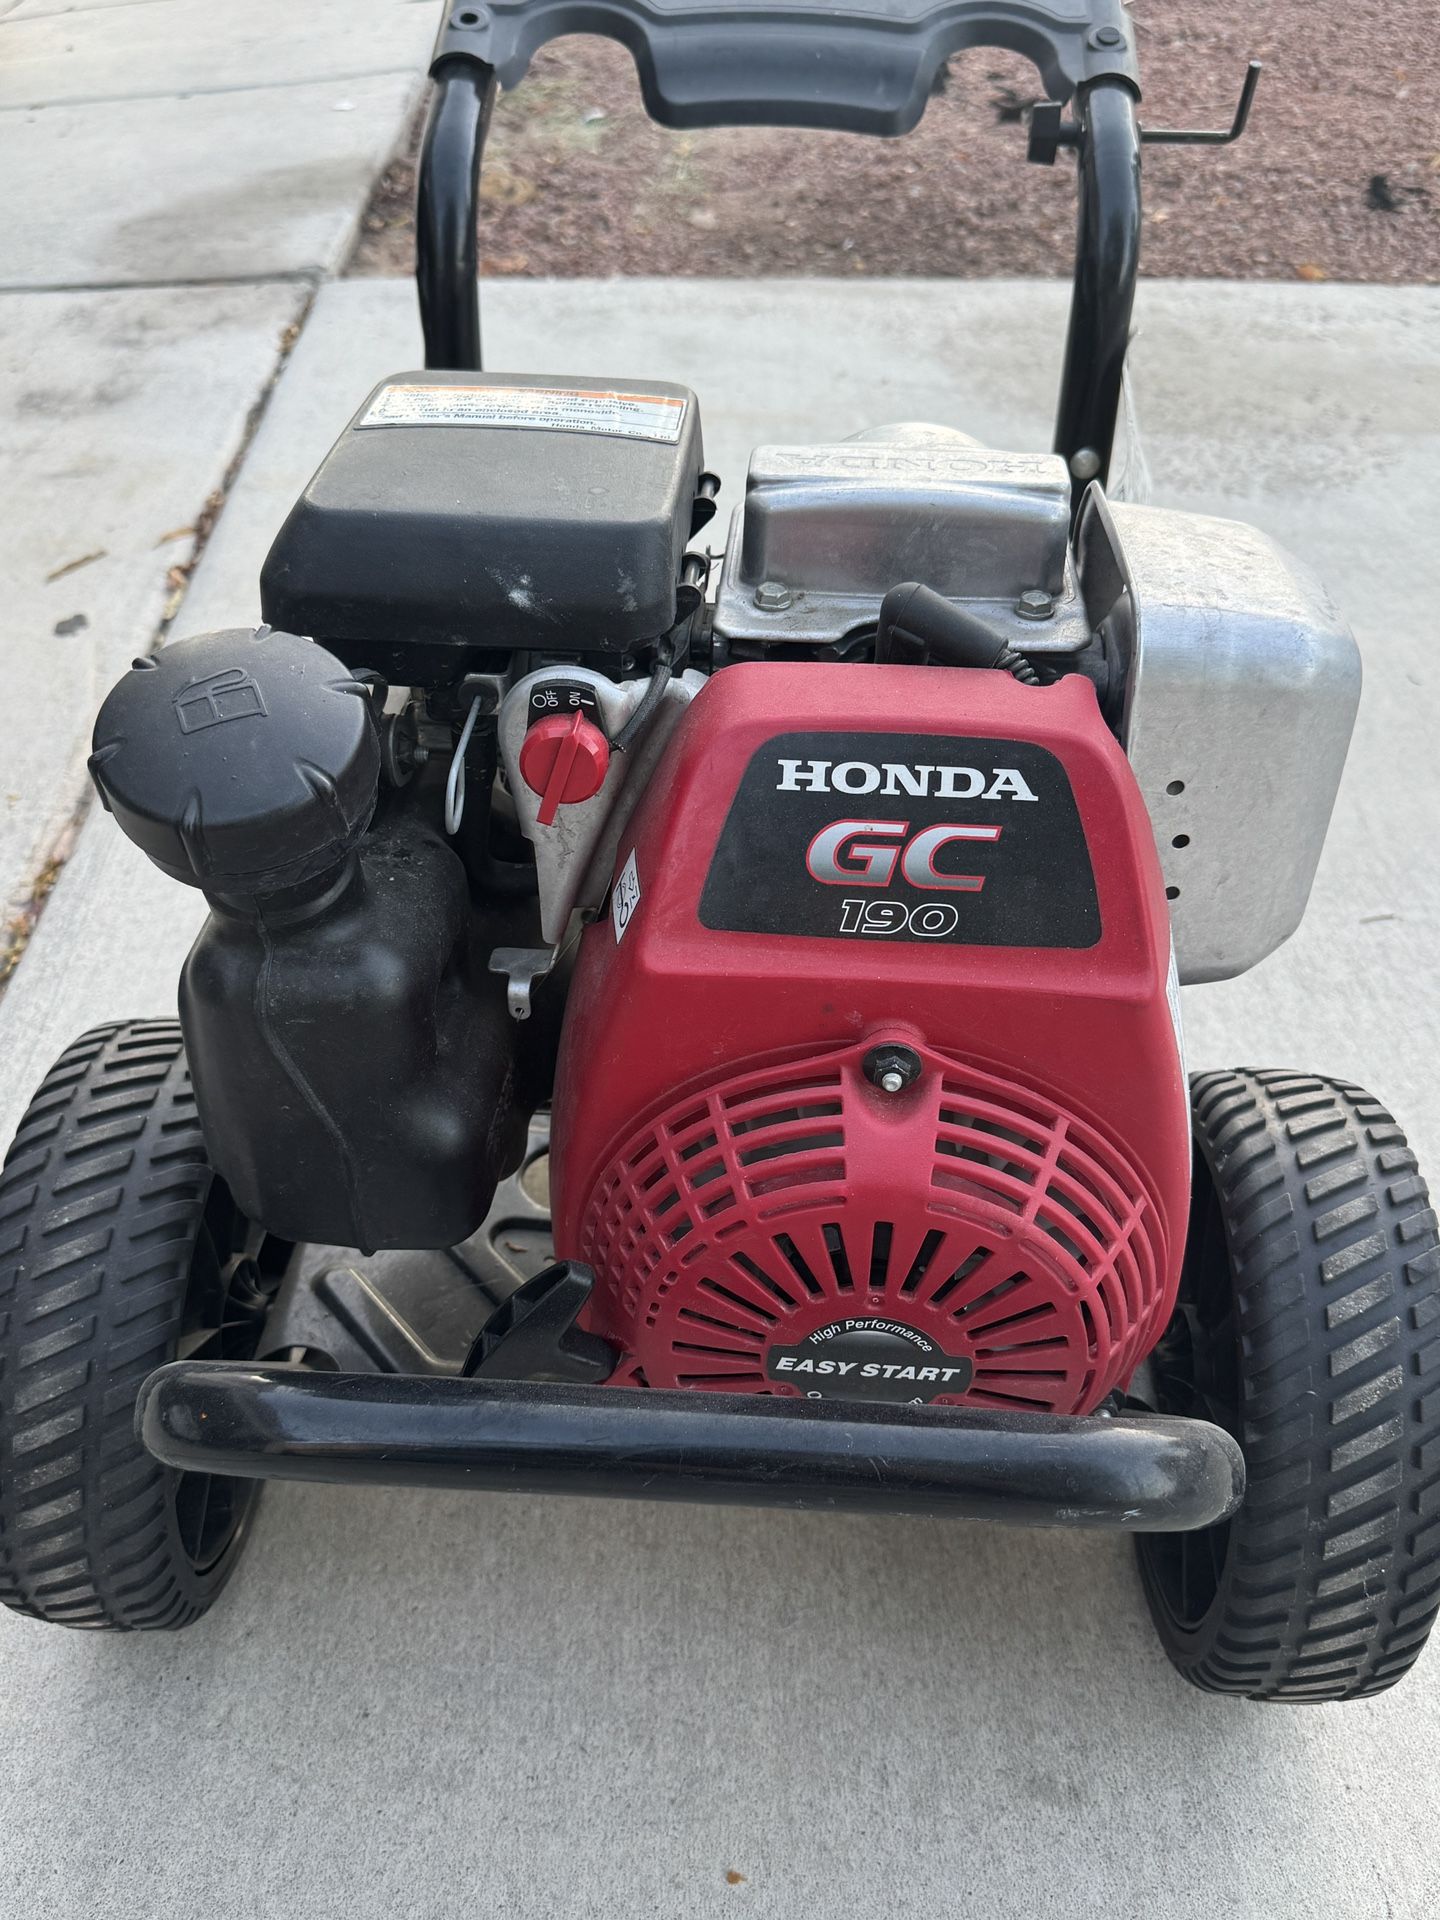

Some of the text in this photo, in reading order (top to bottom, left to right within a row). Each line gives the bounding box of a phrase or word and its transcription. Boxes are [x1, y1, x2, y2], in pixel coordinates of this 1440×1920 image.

[545, 690, 559, 707] OFF
[569, 691, 582, 706] ON
[776, 759, 1039, 802] HONDA
[806, 818, 1003, 892] GC
[839, 899, 959, 937] 190
[809, 1319, 933, 1353] High Performance
[775, 1357, 961, 1382] EASY START
